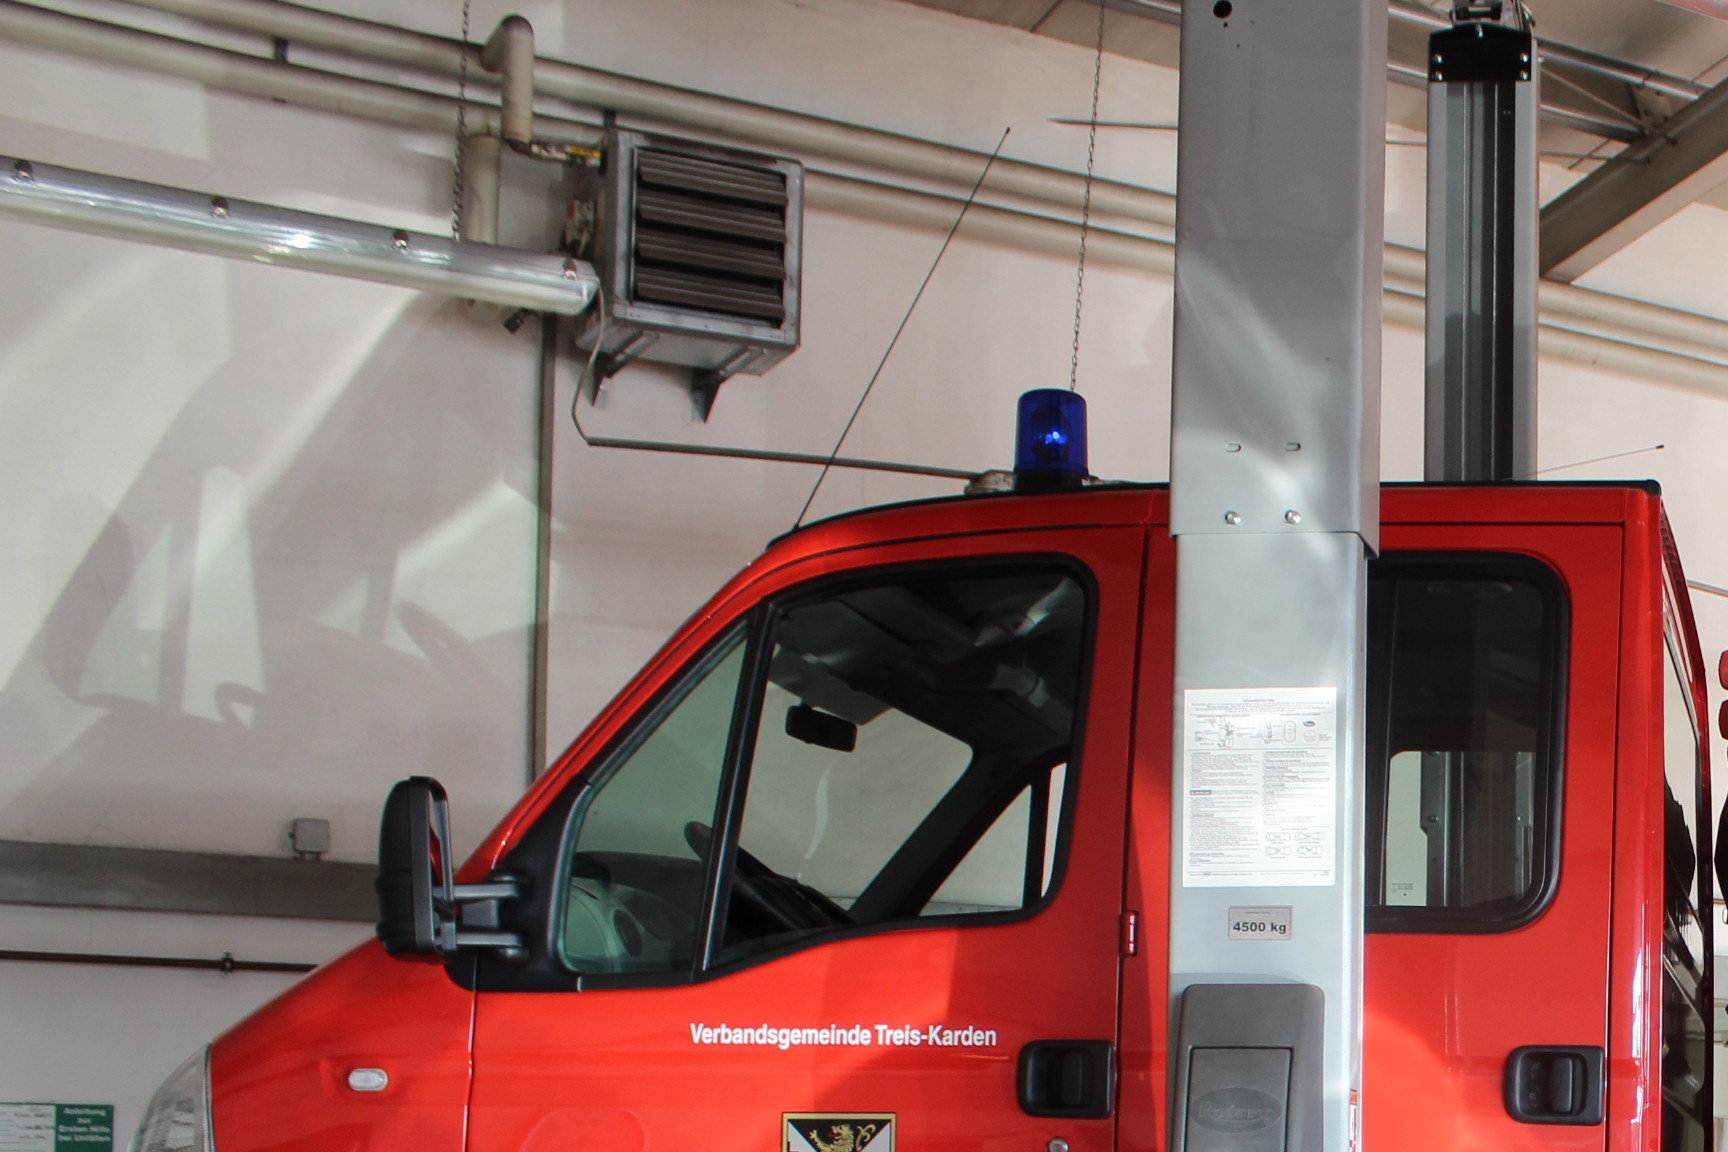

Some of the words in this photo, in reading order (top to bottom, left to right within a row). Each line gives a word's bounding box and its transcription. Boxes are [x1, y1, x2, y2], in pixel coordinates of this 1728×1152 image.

[1233, 922, 1266, 932] 4500
[1270, 922, 1287, 935] kg
[690, 1023, 871, 1050] Verbandsgemeinde
[874, 1024, 997, 1046] Treis-Karden
